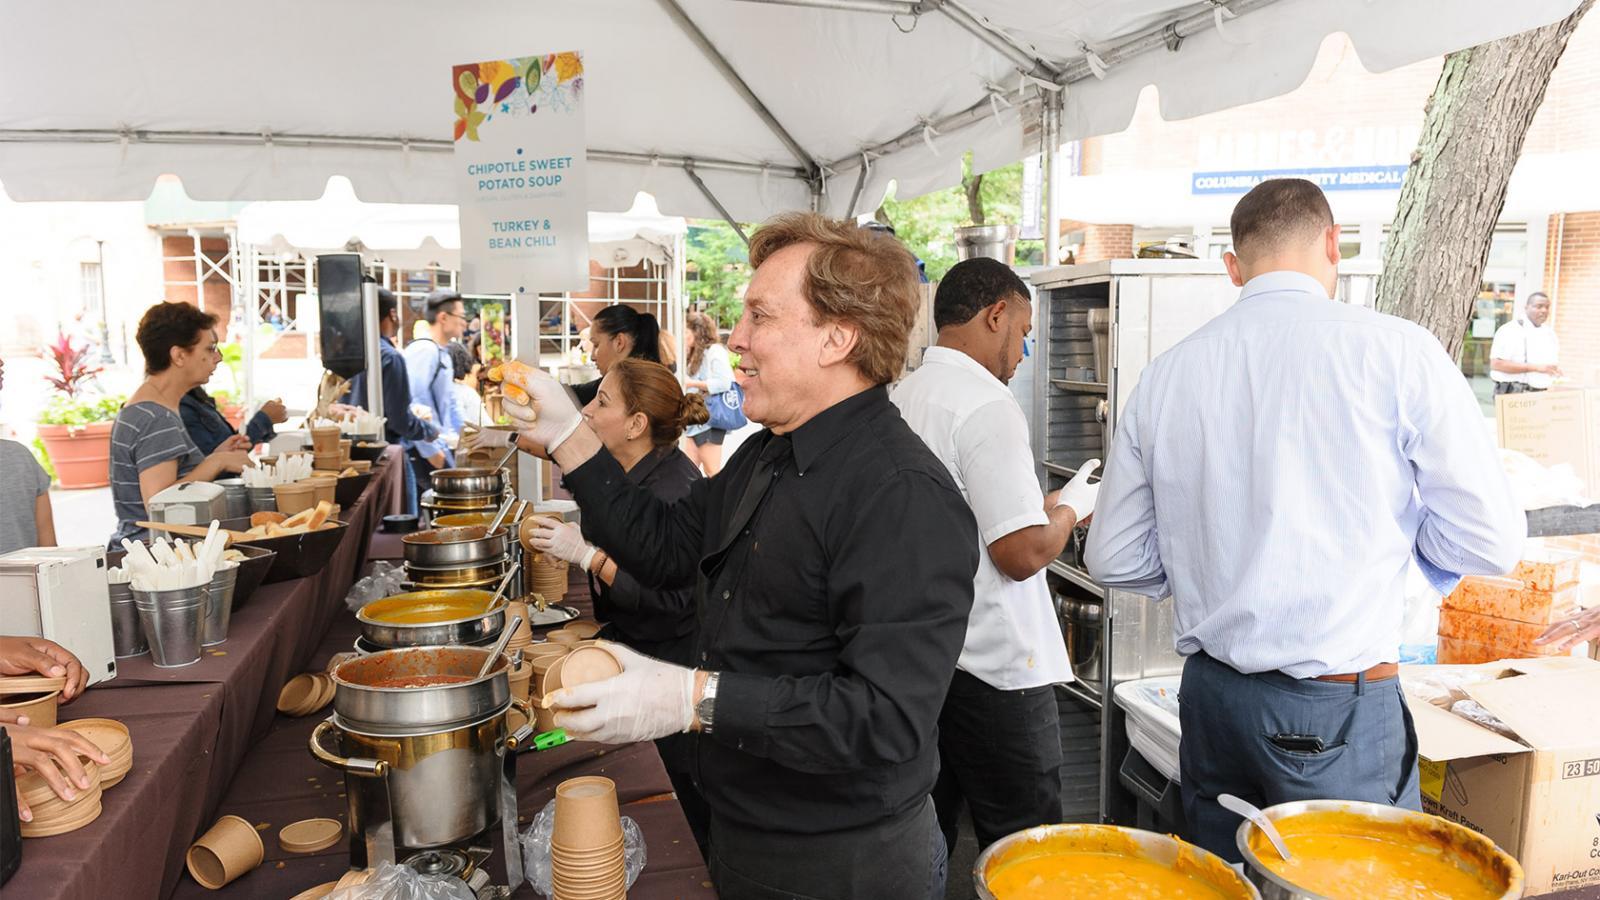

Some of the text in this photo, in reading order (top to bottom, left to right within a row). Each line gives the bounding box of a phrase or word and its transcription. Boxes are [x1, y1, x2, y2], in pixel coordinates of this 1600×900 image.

[467, 157, 573, 175] CHIPOTLE SWEET
[478, 174, 562, 191] POTATO SOUP
[1340, 171, 1401, 185] MEDICAL
[492, 219, 551, 233] TURKEY &
[488, 235, 556, 249] BEAN CHILI
[1567, 763, 1581, 776] 23
[1440, 803, 1459, 821] Kraft
[1592, 837, 1599, 847] 8
[1552, 870, 1588, 881] Kari-Out
